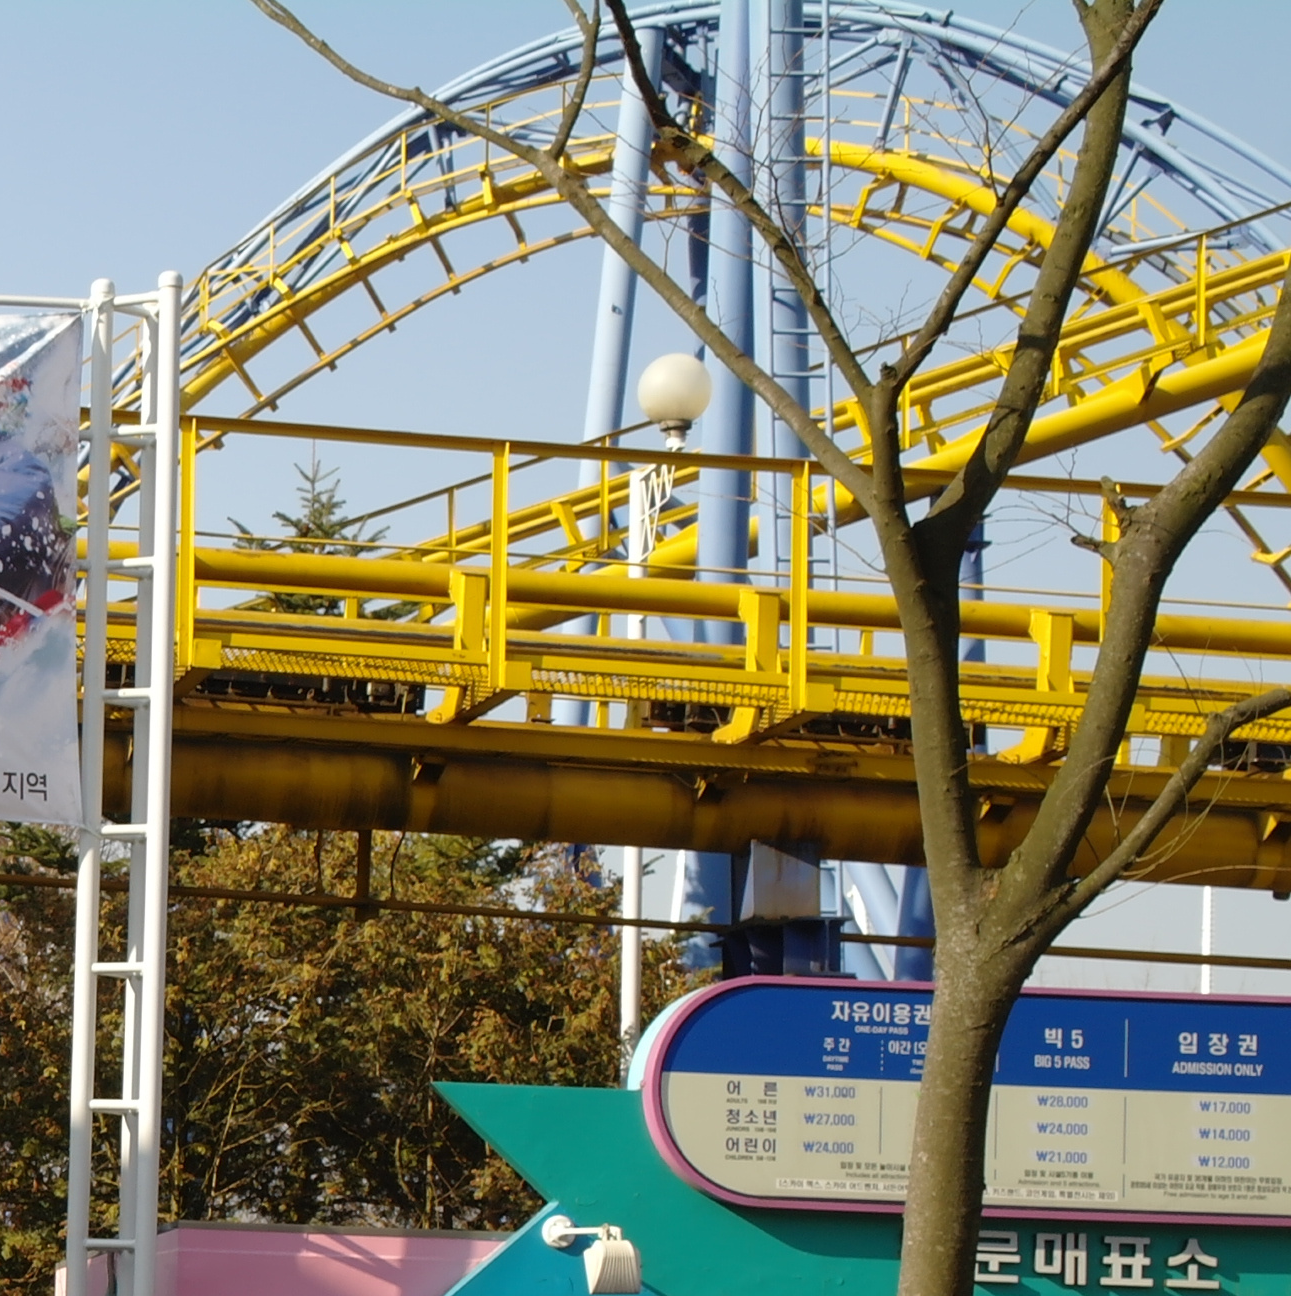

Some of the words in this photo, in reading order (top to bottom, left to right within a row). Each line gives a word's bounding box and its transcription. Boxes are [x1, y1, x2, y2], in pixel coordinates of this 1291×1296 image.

[2, 771, 49, 801] 지역
[831, 1000, 932, 1025] 자유이용권
[1045, 1027, 1063, 1048] 빅
[1071, 1030, 1084, 1048] 5
[1034, 1055, 1052, 1068] BIG
[1054, 1056, 1061, 1068] 5
[1064, 1056, 1090, 1069] PASS
[1172, 1061, 1232, 1076] ADMISSION
[1234, 1063, 1263, 1077] ONLY
[726, 1109, 777, 1126] 청소년
[726, 1137, 776, 1154] 어린이
